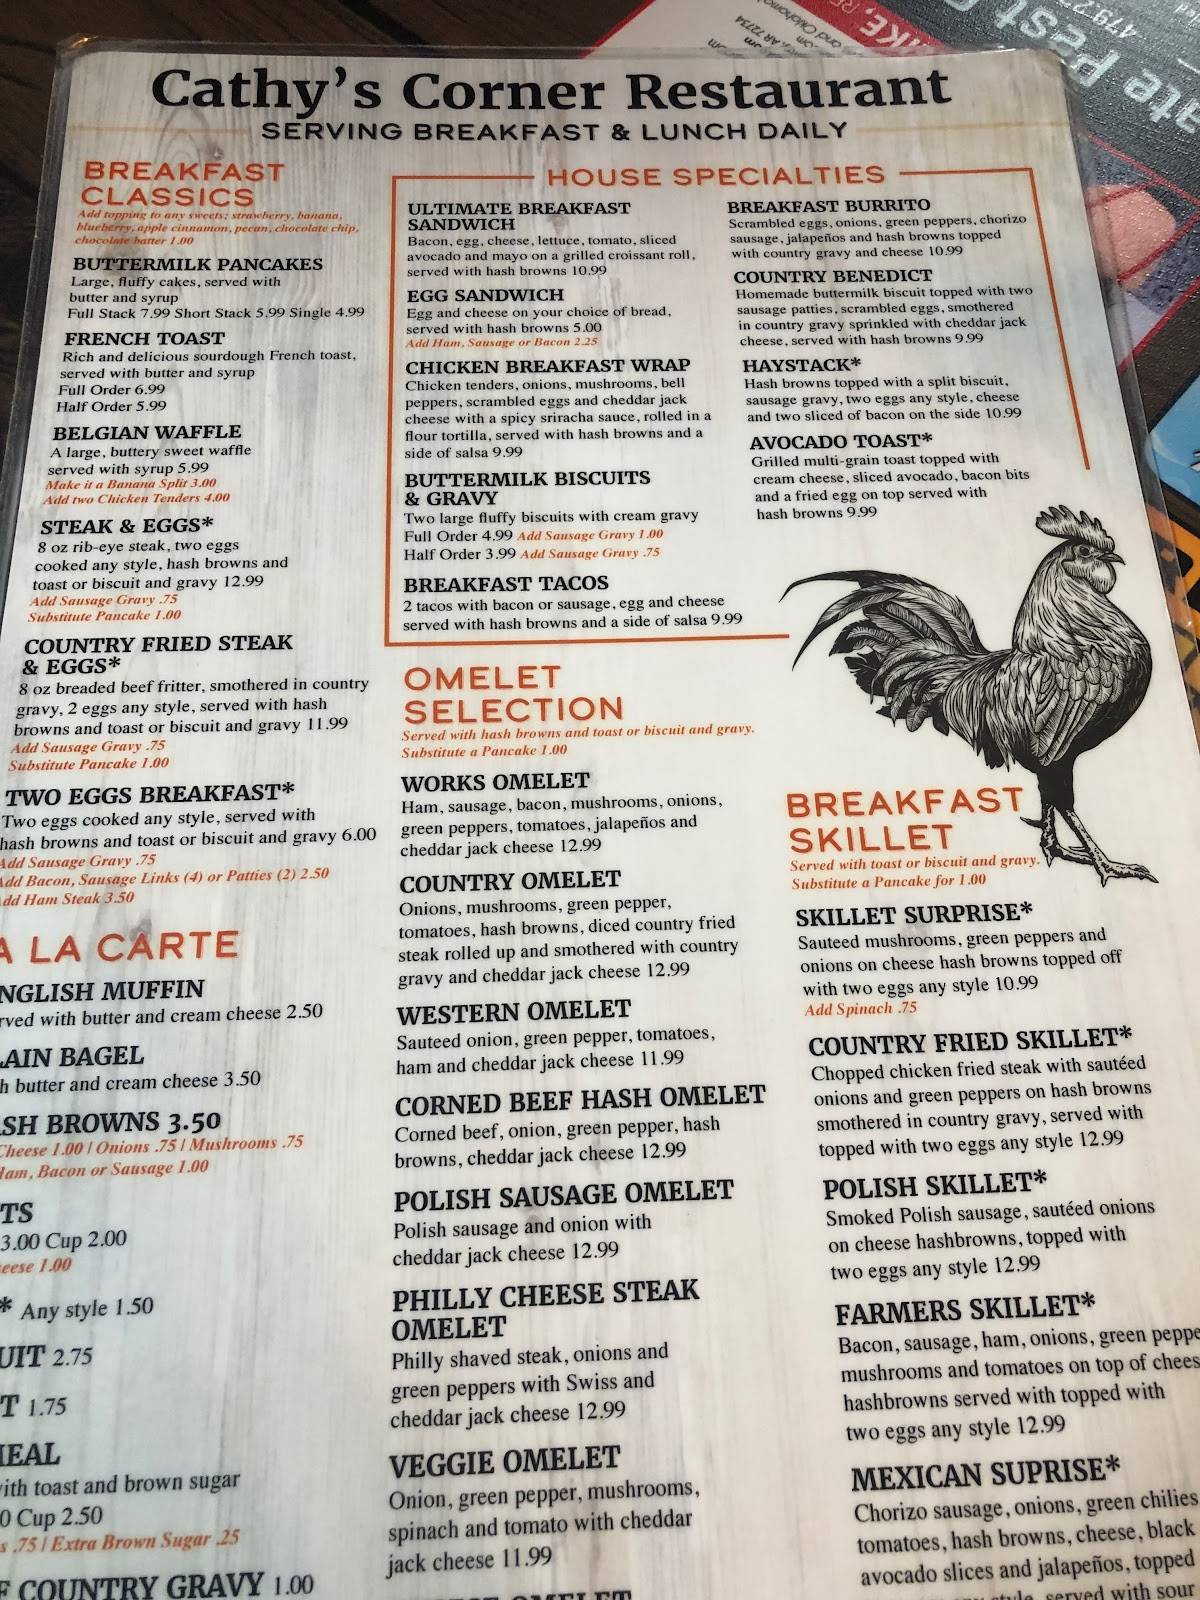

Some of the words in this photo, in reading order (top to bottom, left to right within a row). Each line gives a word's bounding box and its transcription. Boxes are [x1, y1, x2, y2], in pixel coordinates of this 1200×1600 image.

[403, 73, 605, 110] Corner
[626, 70, 952, 109] Restaurant
[262, 122, 402, 140] SERVING
[415, 124, 599, 141] BREAKFAST
[612, 124, 630, 140] &
[642, 123, 746, 141] LUNCH
[758, 122, 847, 139] DAILY
[84, 161, 285, 181] BREAKFAST
[548, 168, 661, 186] HOUSE
[673, 165, 886, 185] SPECIALTIES
[81, 187, 254, 207] CLASSICS
[727, 200, 839, 213] BREAKFAST
[845, 199, 930, 212] BURRITO
[408, 203, 512, 215] ULTIMATE
[518, 202, 631, 214] BREAKFAST
[407, 217, 515, 231] SANDWICH
[408, 237, 452, 247] Bacon,
[456, 239, 483, 248] egg,
[488, 236, 533, 247] cheese,
[538, 236, 584, 246] lettuce,
[588, 237, 636, 246] tomato,
[640, 235, 676, 244] sliced
[73, 257, 211, 272] BUTTERMILK
[217, 258, 323, 271] PANCAKES
[734, 271, 827, 283] COUNTRY
[833, 269, 932, 282] BENEDICT
[407, 289, 448, 302] EGG
[455, 289, 564, 302] SANDWICH
[68, 308, 93, 318] Full
[99, 309, 135, 318] Stack
[141, 308, 170, 318] 7.99
[175, 308, 210, 318] Short
[215, 308, 251, 318] Stack
[256, 308, 285, 318] 5.99
[290, 307, 331, 320] Single
[336, 307, 364, 317] 4.99
[64, 333, 150, 345] FRENCH
[157, 332, 225, 345] TOAST
[407, 339, 429, 347] Add
[432, 339, 464, 347] Ham,
[469, 339, 514, 348] Sausage
[534, 338, 570, 346] Bacon
[406, 361, 499, 374] CHICKEN
[506, 360, 625, 373] BREAKFAST
[630, 359, 690, 372] WRAP
[58, 385, 85, 395] Full
[91, 385, 131, 395] Order
[135, 384, 165, 394] 6.99
[53, 426, 149, 440] BELGIAN
[154, 425, 241, 439] WAFFLE
[750, 435, 847, 450] AVOCADO
[46, 481, 80, 489] Make
[84, 480, 92, 489] it
[107, 480, 155, 488] Banana
[159, 479, 187, 490] Split
[191, 479, 216, 487] 3.00
[405, 472, 548, 487] BUTTERMILK
[555, 471, 650, 485] BISCUITS
[405, 492, 420, 506] &
[427, 491, 498, 505] GRAVY
[757, 508, 787, 519] hash
[793, 508, 843, 519] browns
[847, 507, 877, 517] 9.99
[41, 520, 113, 534] STEAK
[120, 519, 135, 533] &
[404, 577, 532, 593] BREAKFAST
[539, 576, 608, 591] TACOS
[25, 637, 136, 654] COUNTRY
[141, 636, 211, 652] FRIED
[219, 635, 293, 651] STEAK
[22, 660, 38, 675] &
[405, 666, 560, 691] OMELET
[405, 697, 622, 724] SELECTION
[14, 724, 69, 736] browns
[75, 722, 102, 735] and
[108, 723, 143, 734] toast
[149, 725, 165, 733] or
[170, 720, 220, 732] biscuit
[225, 719, 252, 731] and
[258, 722, 300, 734] gravy
[309, 717, 348, 730] 11.99
[402, 747, 465, 758] Substitute
[482, 745, 536, 756] Pancake
[542, 745, 567, 754] 1.00
[401, 775, 485, 792] WORKS
[493, 772, 590, 790] OMELET
[5, 789, 61, 806] TWO
[68, 787, 131, 805] EGGS
[787, 787, 1024, 817] BREAKFAST
[790, 824, 952, 853] SKILLET
[26, 876, 74, 886] Bacon,
[79, 874, 136, 887] Sausage
[141, 872, 179, 883] Links
[184, 872, 202, 883] (4)
[227, 870, 272, 881] Patties
[277, 869, 295, 881] (2)
[301, 868, 329, 879] 2.50
[400, 873, 515, 893] COUNTRY
[522, 870, 621, 889] OMELET
[796, 907, 896, 927] SKILLET
[30, 935, 80, 964] LA
[97, 930, 239, 962] CARTE
[396, 1003, 520, 1025] WESTERN
[528, 999, 631, 1020] OMELET
[809, 1034, 926, 1056] COUNTRY
[933, 1032, 1008, 1052] FRIED
[396, 1094, 501, 1116] CORNED
[509, 1091, 573, 1112] BEEF
[581, 1088, 652, 1109] HASH
[660, 1085, 766, 1106] OMELET
[394, 1188, 490, 1212] POLISH
[500, 1184, 617, 1208] SAUSAGE
[625, 1179, 734, 1203] OMELET
[823, 1177, 918, 1200] POLISH
[1, 1234, 40, 1251] 3.00
[46, 1233, 82, 1253] Cup
[88, 1230, 127, 1247] 2.00
[393, 1287, 492, 1312] PHILLY
[500, 1283, 604, 1307] CHEESE
[613, 1279, 700, 1303] STEAK
[835, 1300, 961, 1326] FARMERS
[392, 1315, 506, 1341] OMELET
[389, 1451, 495, 1479] VEGGIE
[503, 1445, 621, 1473] OMELET
[851, 1463, 982, 1492] MEXICAN
